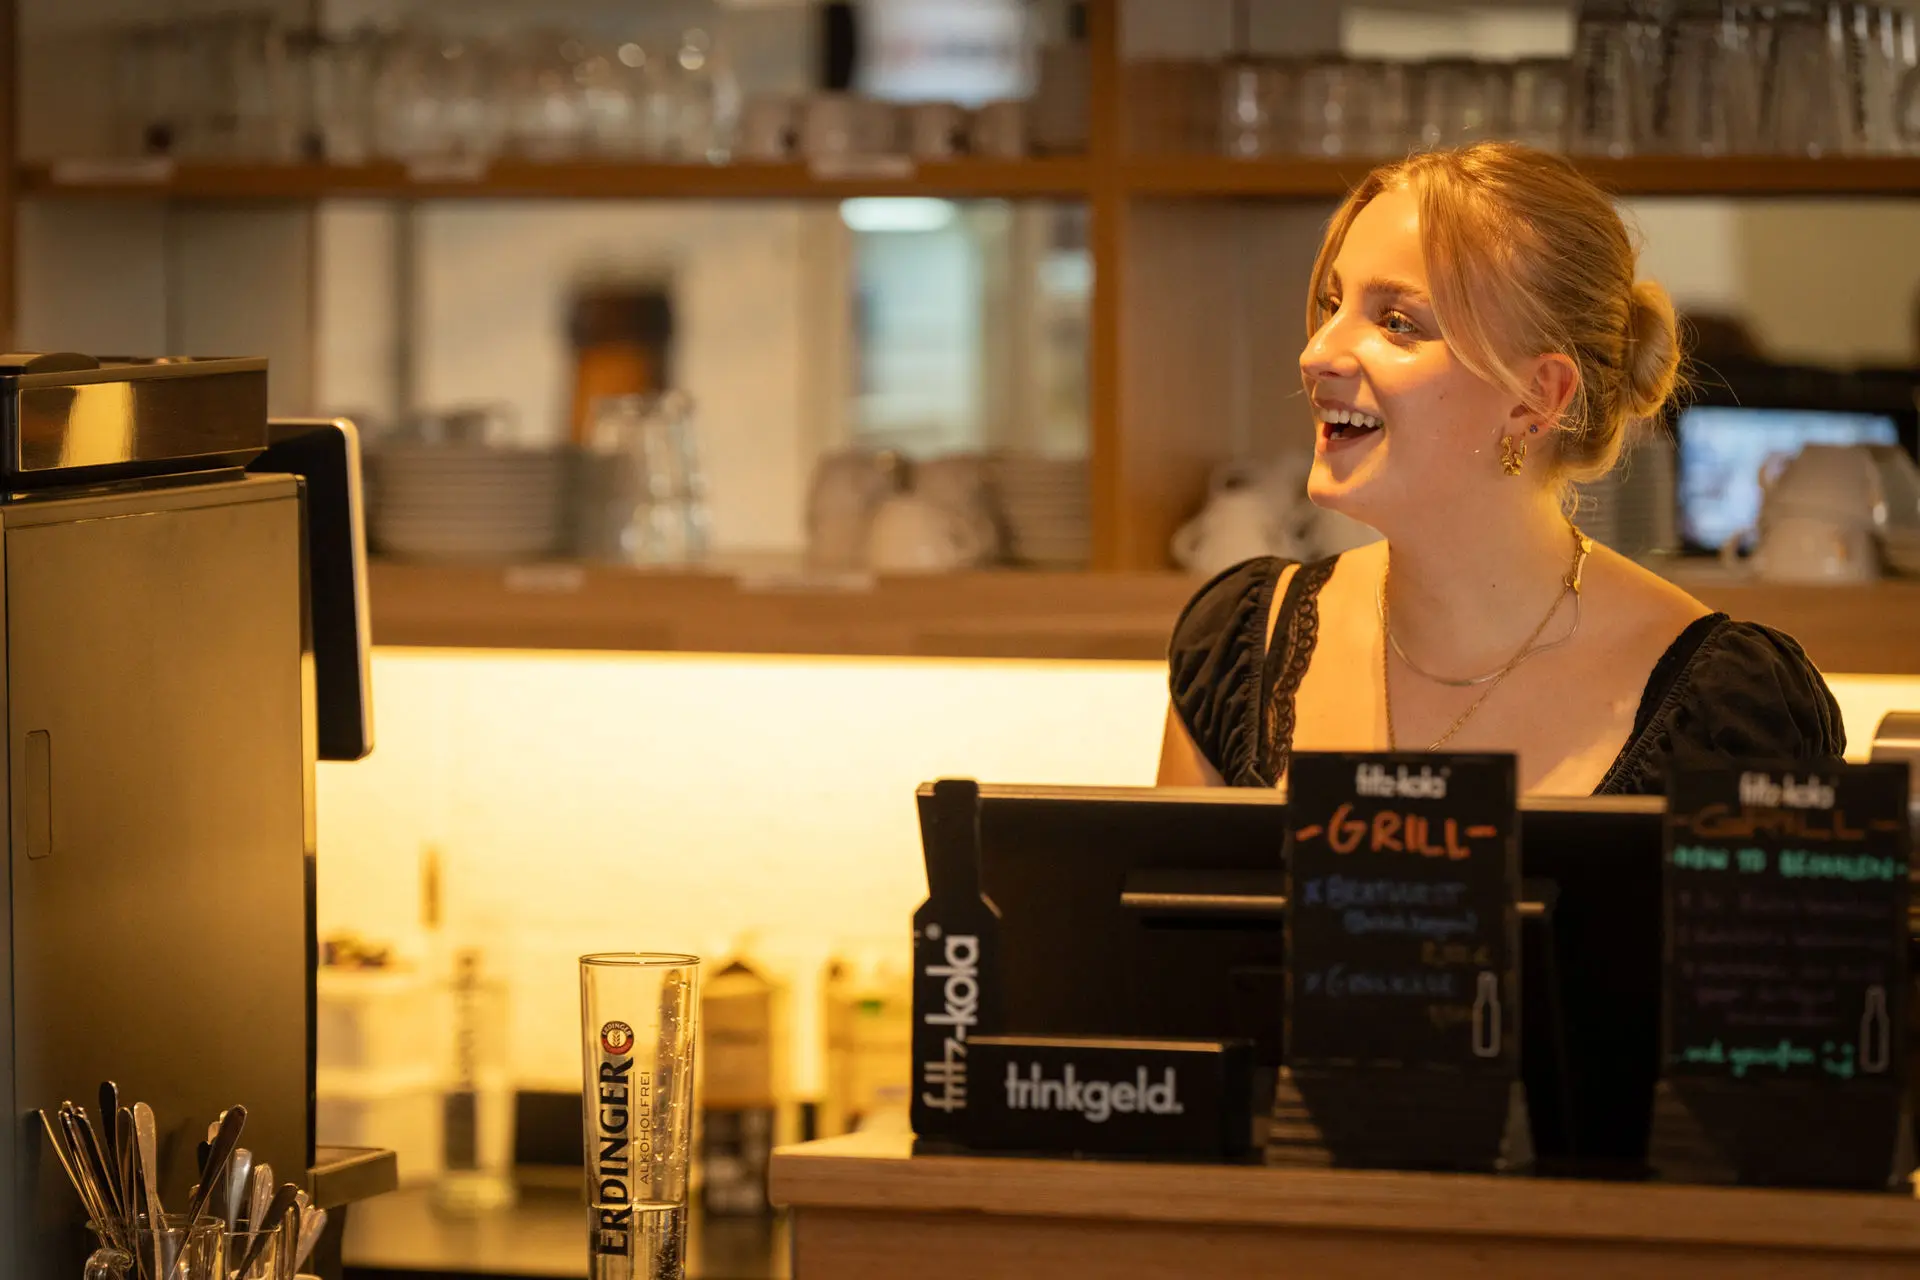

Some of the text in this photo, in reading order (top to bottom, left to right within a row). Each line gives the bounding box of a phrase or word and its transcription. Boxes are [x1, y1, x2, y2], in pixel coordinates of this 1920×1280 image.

[639, 1071, 651, 1185] ALKOHOLFREI
[1004, 1062, 1184, 1123] trinkgeld.
[599, 1055, 634, 1257] ERDINGER
